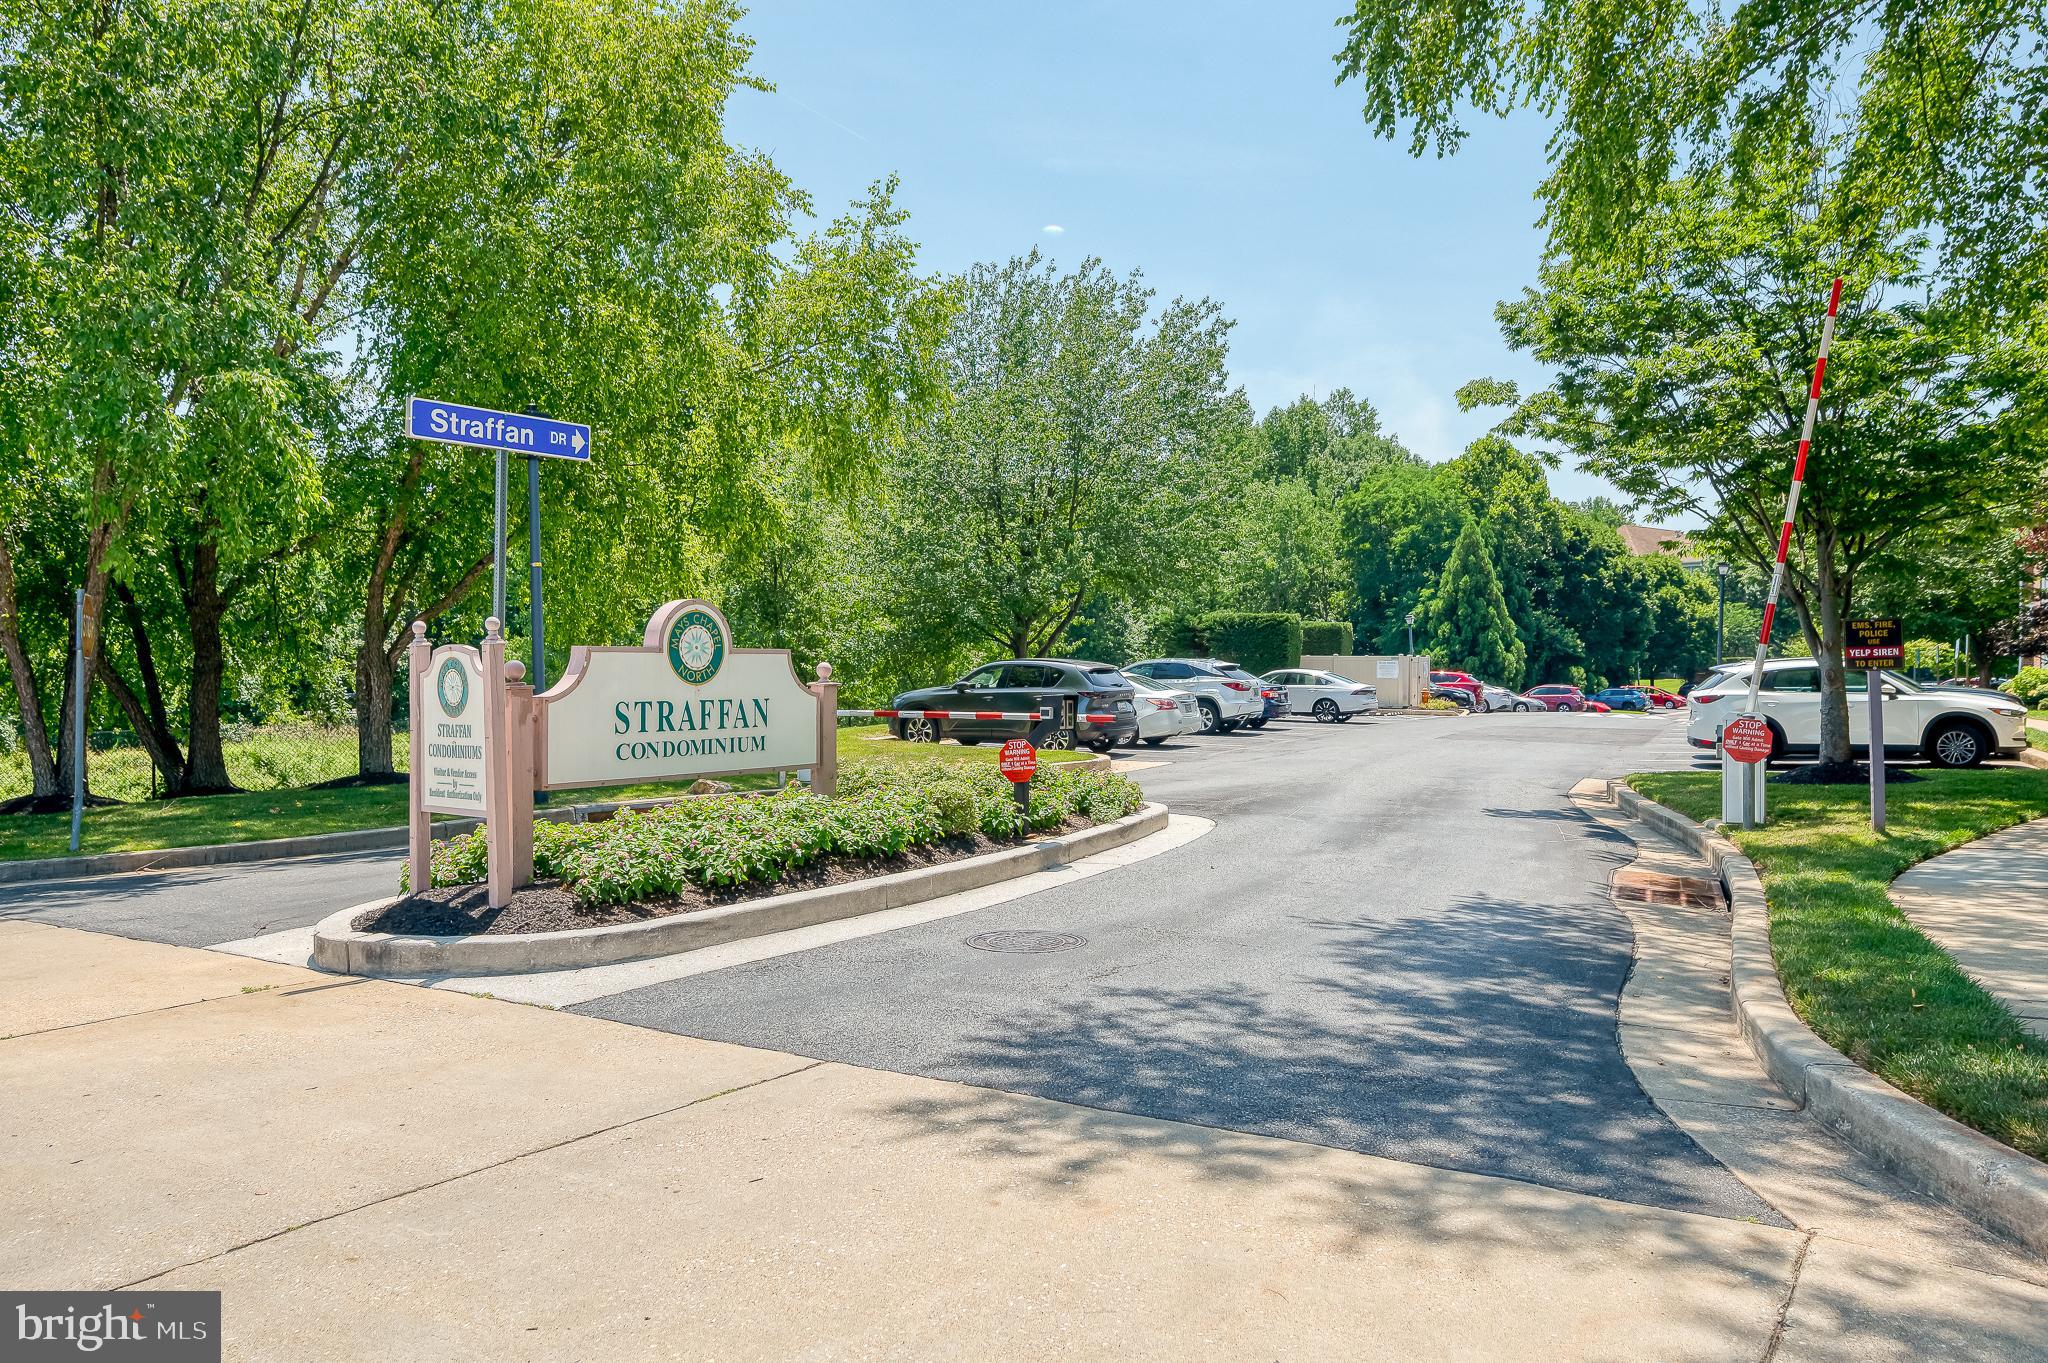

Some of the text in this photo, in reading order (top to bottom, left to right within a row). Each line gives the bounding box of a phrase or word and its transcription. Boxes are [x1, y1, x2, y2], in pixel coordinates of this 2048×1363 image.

[430, 408, 566, 446] Straffan DR
[1874, 620, 1896, 628] FIRE,
[672, 614, 722, 650] MAYS CHAPEL
[1859, 630, 1888, 638] POLICE
[1850, 648, 1899, 656] YELP SIREN
[678, 664, 715, 682] NORTH
[614, 698, 770, 734] STRAFFAN
[438, 724, 472, 738] STRAFFAN
[1739, 720, 1762, 729] STOP
[1732, 728, 1764, 736] WARNING
[428, 744, 482, 760] CONDOMINIUMS
[616, 736, 766, 760] CONDOMINIUM
[1008, 741, 1026, 749] STOP
[452, 779, 457, 790] by
[430, 788, 481, 803] Resident Authorization Only
